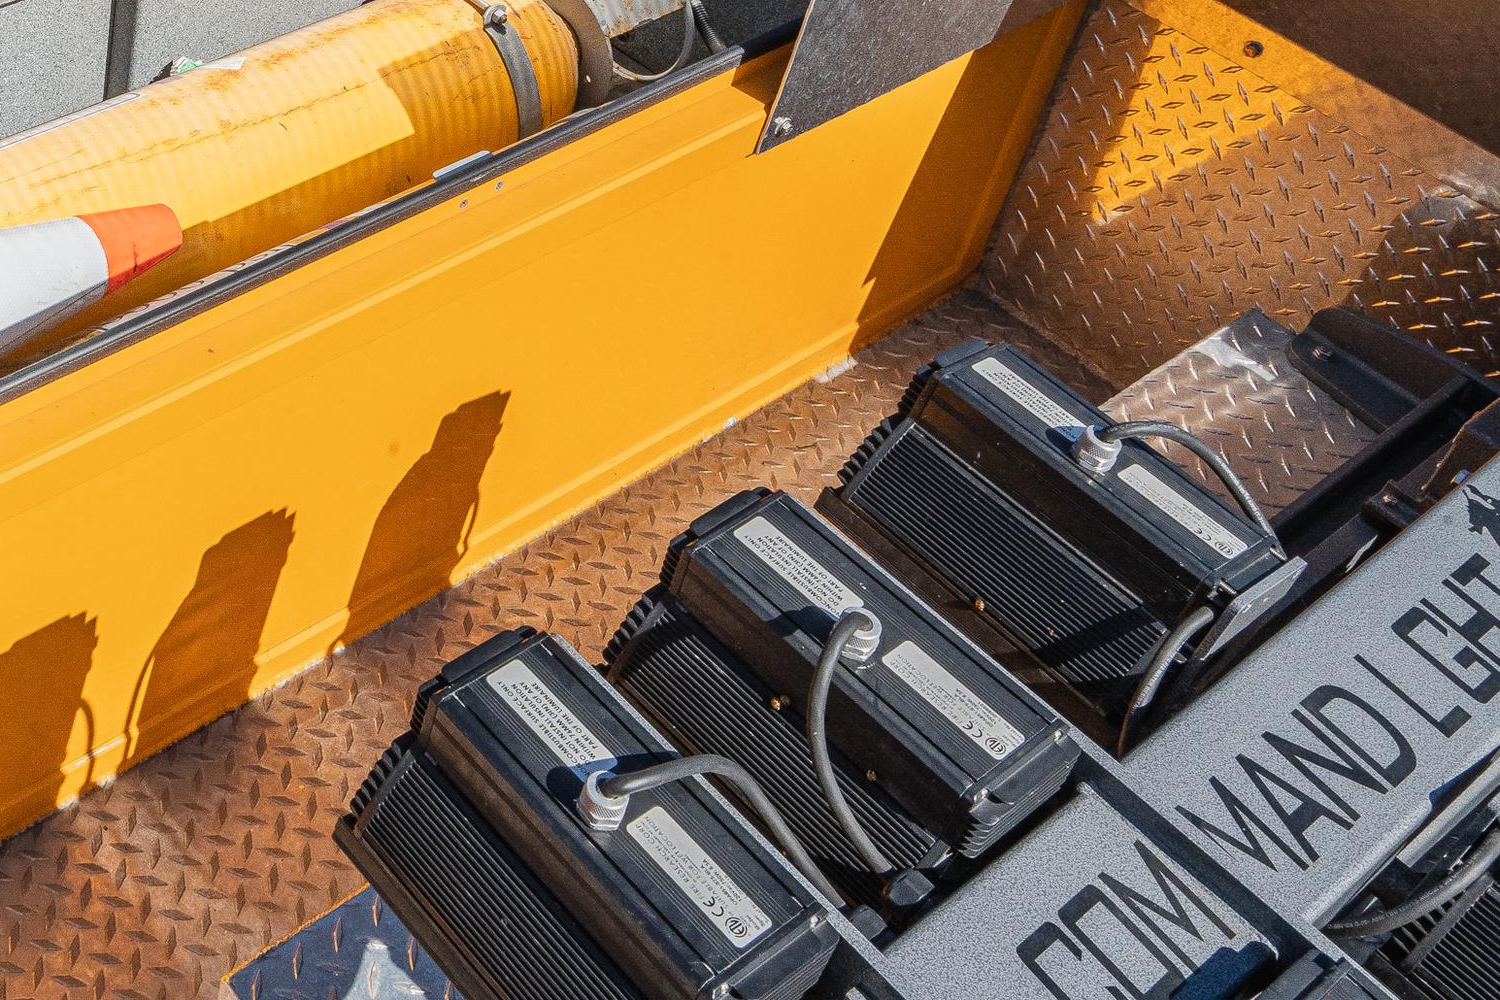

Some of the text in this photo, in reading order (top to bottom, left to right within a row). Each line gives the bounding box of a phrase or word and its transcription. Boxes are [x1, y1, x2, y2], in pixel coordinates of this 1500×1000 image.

[743, 534, 760, 549] ONLY
[764, 534, 777, 546] ANY
[775, 535, 806, 562] LUMINAIRE
[757, 537, 791, 566] INSULATION
[760, 548, 786, 571] SURFACE
[791, 566, 814, 585] INSTALL
[807, 561, 817, 571] THE
[814, 584, 827, 596] NOT
[821, 582, 842, 601] WITHIN
[827, 578, 843, 592] PART
[519, 680, 533, 695] ANY
[532, 694, 542, 704] OF
[511, 683, 589, 765] DO NOT INSTALL INSULATION
[531, 681, 597, 749] PART OF THE LUMINAIRE
[497, 680, 590, 777] NONCOMBUSTIBLE SURFACE ONLY
[574, 737, 595, 759] WITHIN
[654, 844, 690, 883] RESEARCH
